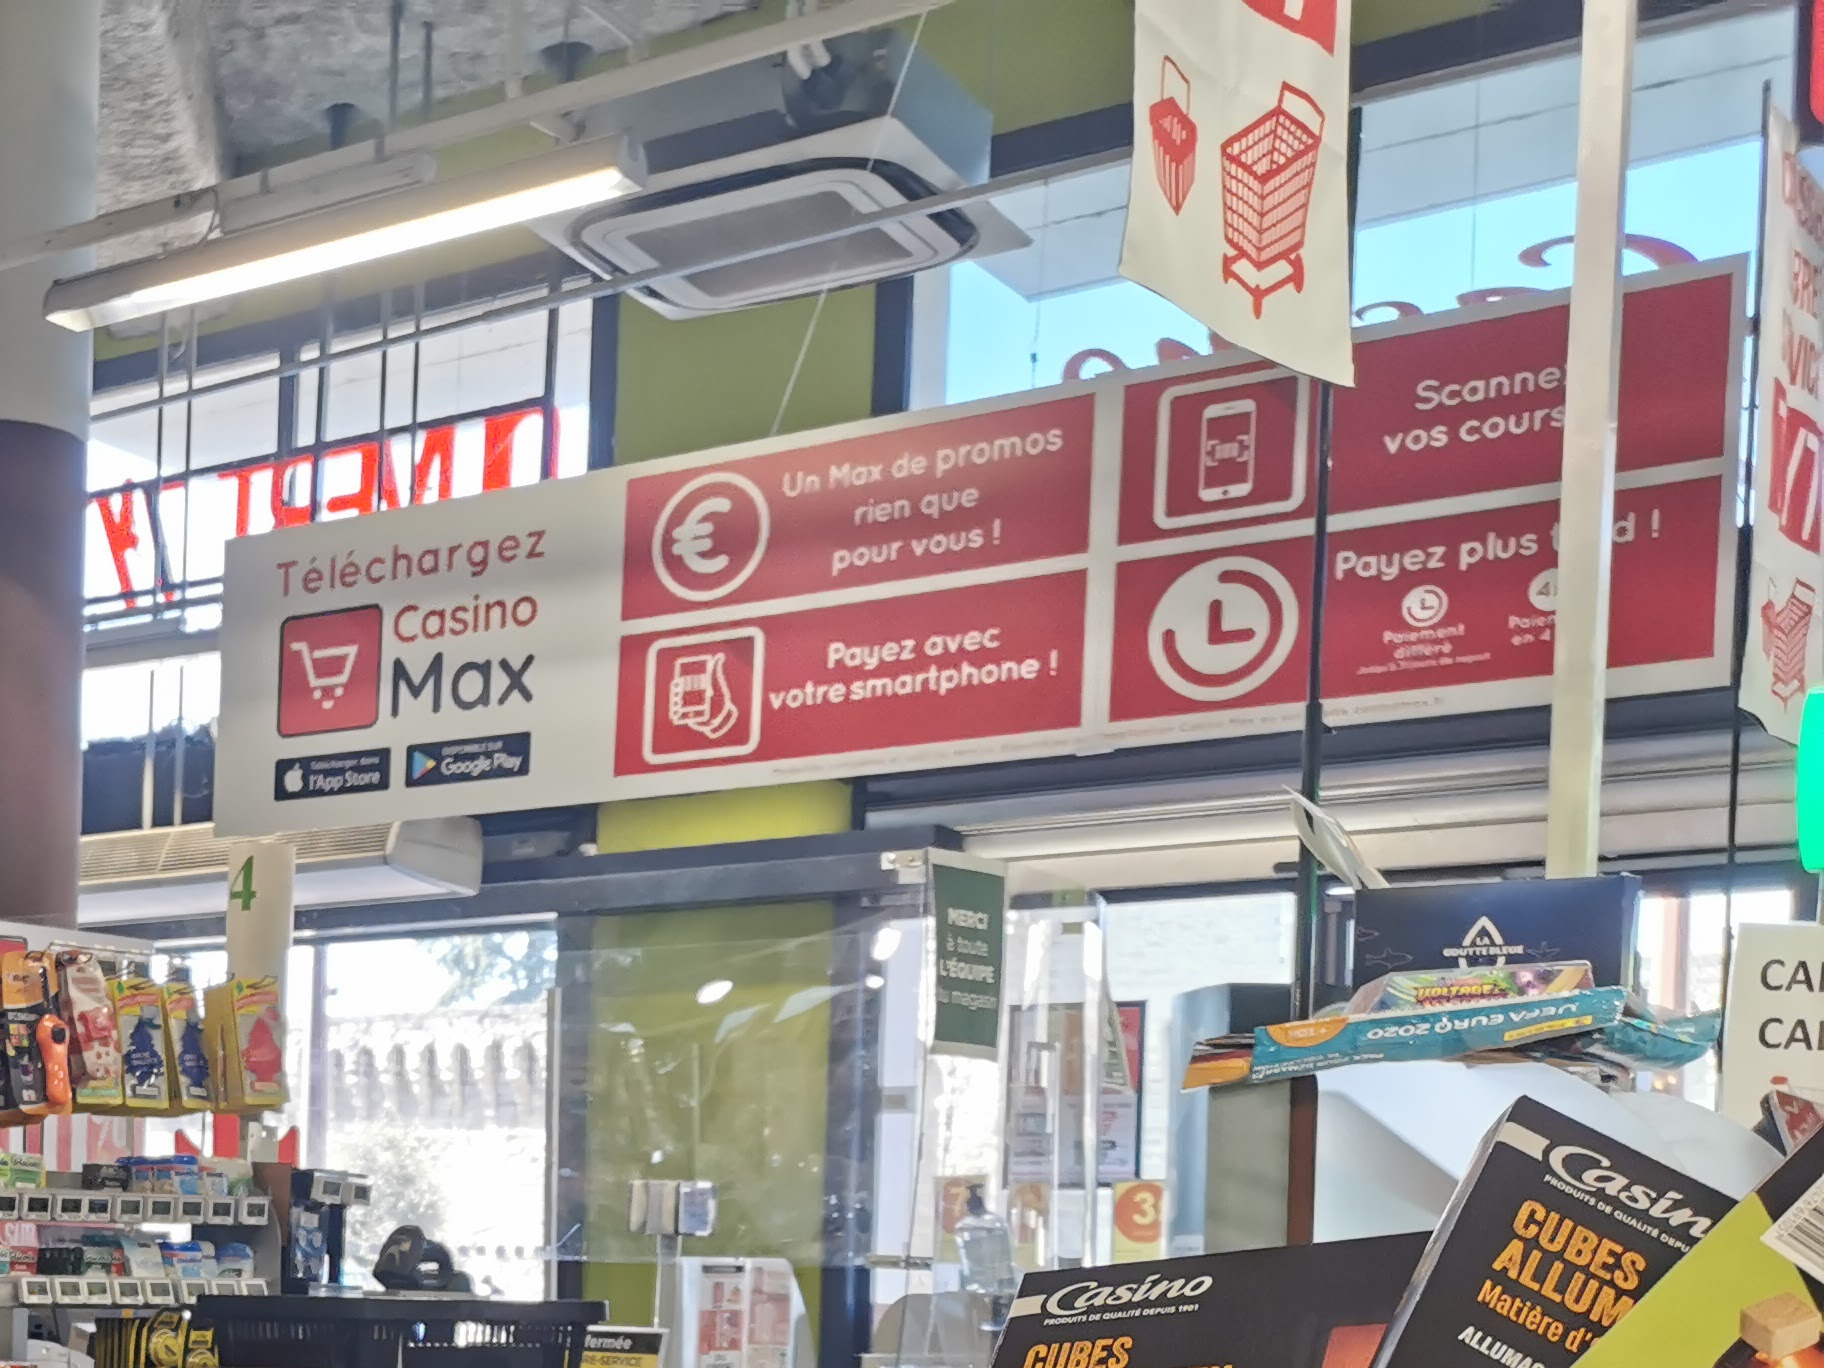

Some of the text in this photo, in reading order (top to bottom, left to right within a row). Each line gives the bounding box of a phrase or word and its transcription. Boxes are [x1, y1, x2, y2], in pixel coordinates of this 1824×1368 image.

[782, 427, 1064, 498] Un Max de promos
[1382, 424, 1450, 455] vos
[853, 486, 981, 529] rien que
[276, 529, 546, 598] Téléchargez
[831, 538, 903, 577] pour
[909, 527, 985, 557] vous
[1335, 544, 1447, 581] Payez
[1459, 530, 1539, 573] plus
[394, 593, 538, 644] Casino
[826, 625, 1001, 671] Payez avec
[391, 651, 535, 718] Max
[769, 683, 847, 712] votre
[849, 655, 1041, 701] smartphone
[345, 770, 380, 788] Store
[440, 752, 523, 777] Google Play
[229, 855, 255, 911] 4
[947, 907, 989, 930] MERCI
[1760, 959, 1824, 992] CA
[1367, 1022, 1432, 1040] 2020
[1758, 1018, 1824, 1051] CA
[1133, 1191, 1156, 1225] 3
[1543, 1174, 1597, 1207] PRODUITS
[1596, 1199, 1613, 1215] DE
[1613, 1208, 1660, 1239] QUALITÉ
[1512, 1200, 1647, 1291] CUBES
[1044, 1273, 1213, 1316] Casino
[1044, 1314, 1086, 1326] PRODUITS
[1087, 1312, 1100, 1322] DE
[1102, 1308, 1141, 1321] QUALITÉ
[1143, 1305, 1176, 1317] DEPUIS
[1477, 1279, 1564, 1345] Matière
